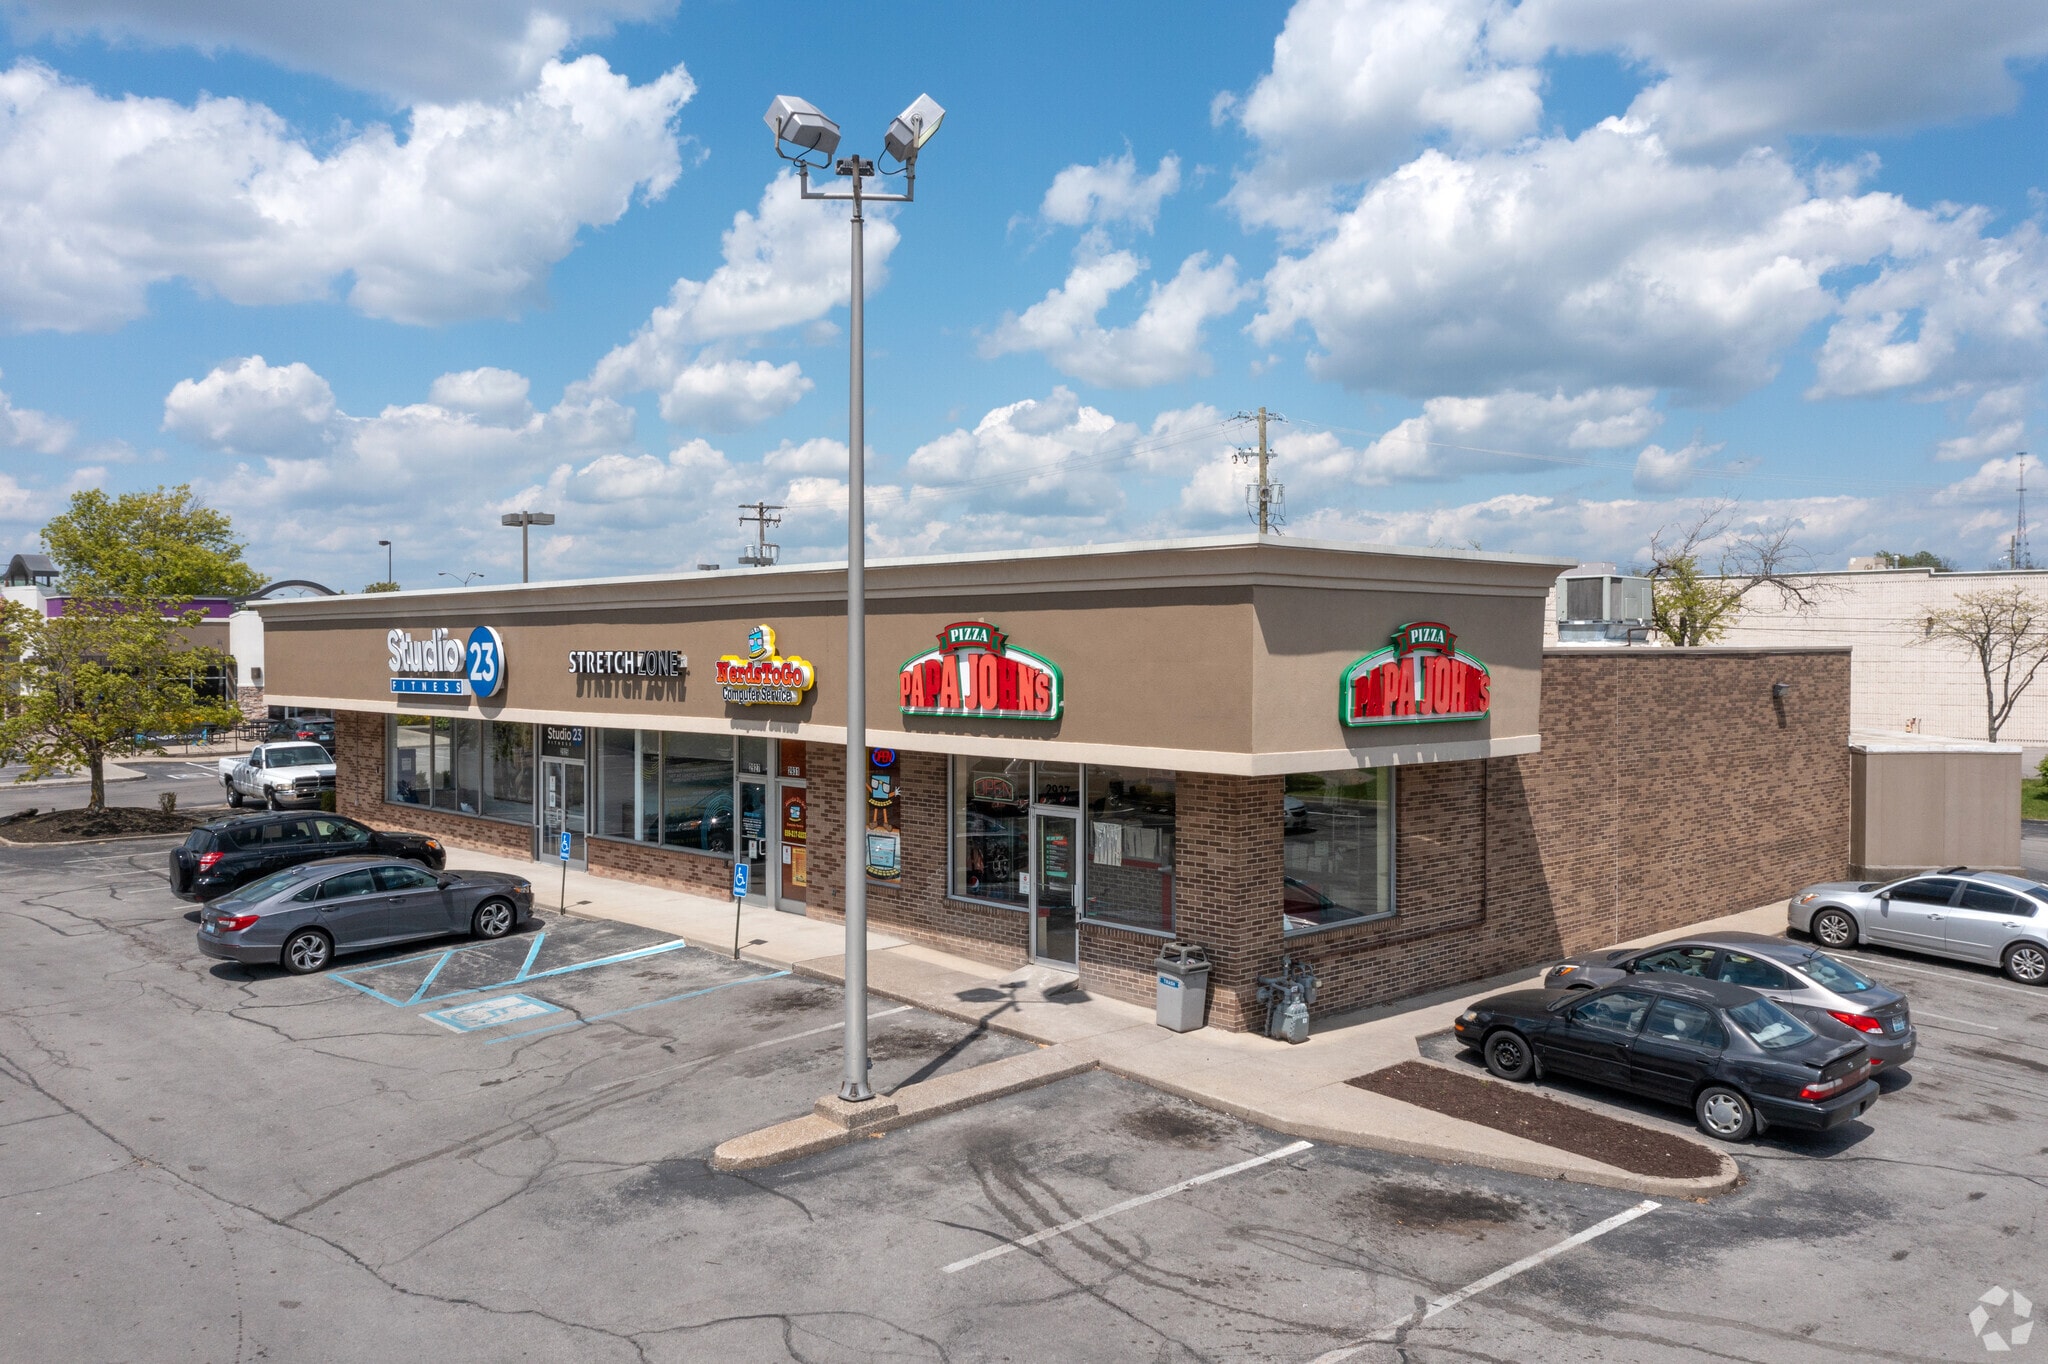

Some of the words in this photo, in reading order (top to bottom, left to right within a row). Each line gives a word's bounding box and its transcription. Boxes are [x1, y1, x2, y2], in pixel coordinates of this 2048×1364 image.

[950, 627, 988, 642] PIZZA
[1410, 628, 1445, 643] PIZZA
[387, 628, 462, 673] Studio
[469, 641, 496, 682] 23
[568, 650, 634, 674] STRETCH
[637, 650, 681, 676] ZONE
[715, 661, 803, 687] NerdsToGo
[899, 654, 961, 708] PAPA
[964, 653, 1050, 712] JOHN'S
[392, 680, 461, 693] FITNESS
[722, 687, 760, 703] Computer
[761, 687, 792, 702] Service
[1353, 657, 1416, 718] PAPA
[547, 726, 571, 740] Studio
[572, 728, 582, 741] 23
[873, 750, 893, 763] OPEN
[975, 779, 1013, 798] OPEN
